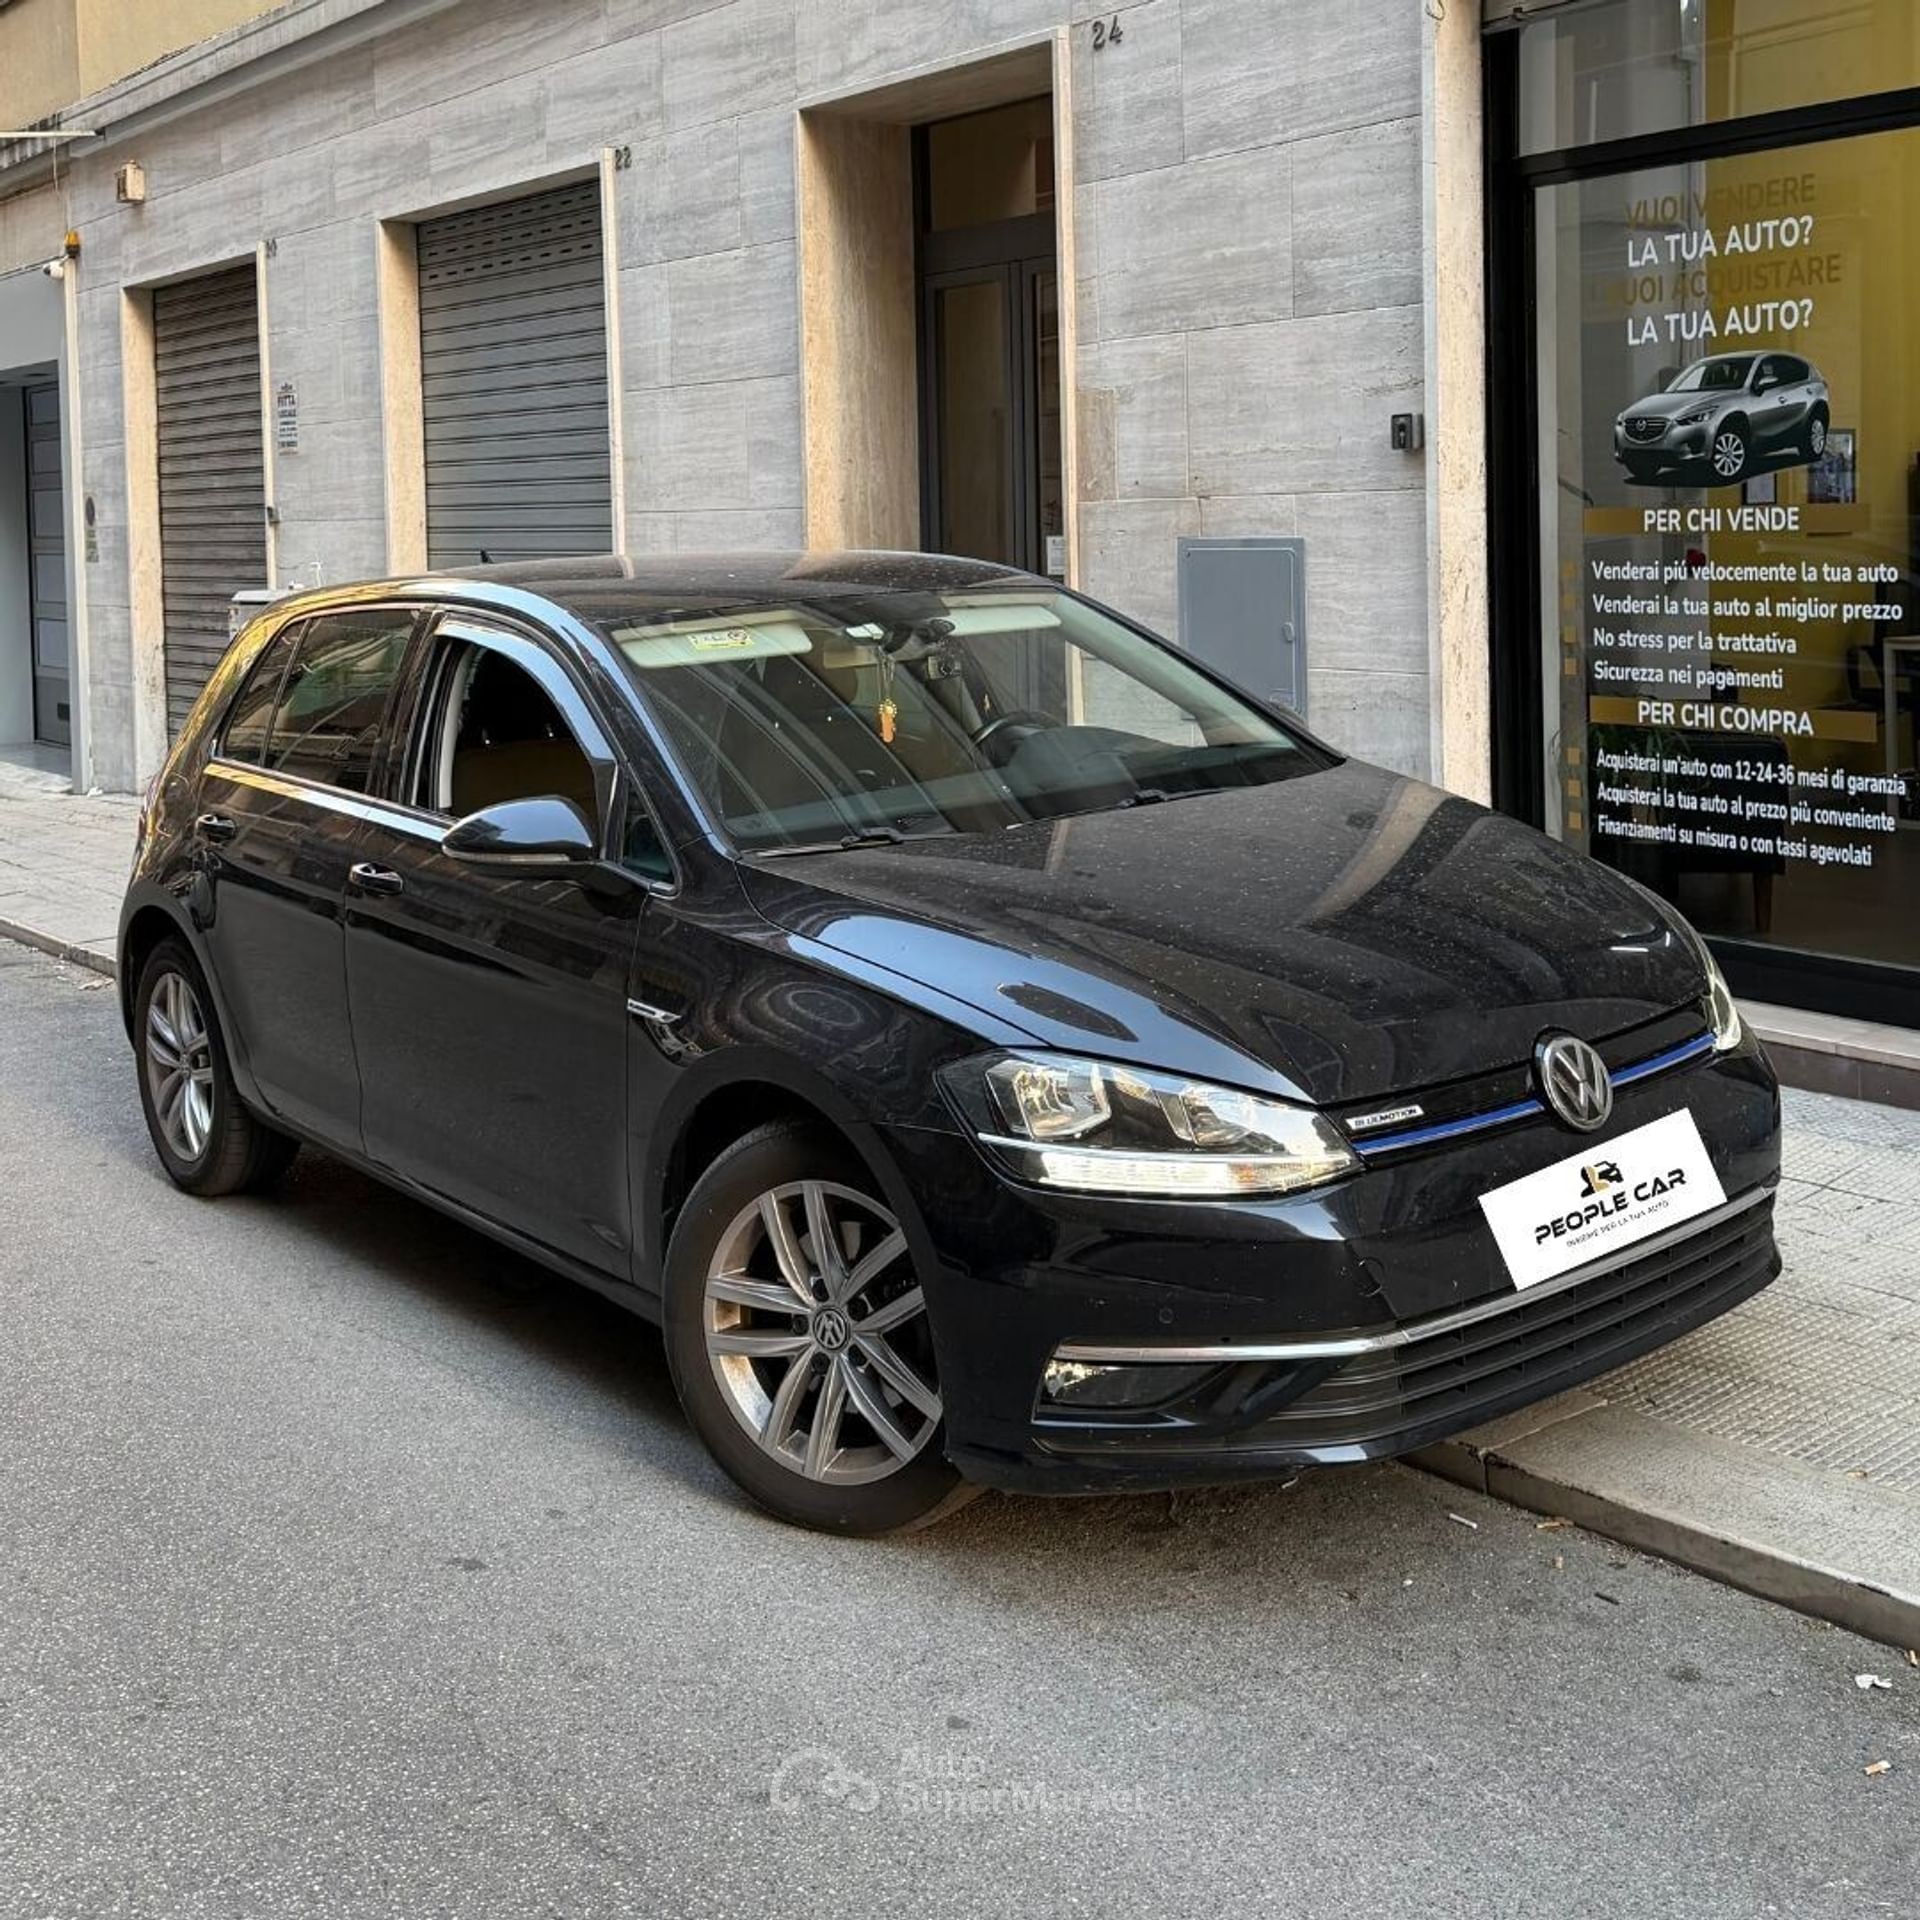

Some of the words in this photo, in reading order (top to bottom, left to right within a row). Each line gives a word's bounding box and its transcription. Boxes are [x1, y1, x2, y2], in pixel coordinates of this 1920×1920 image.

[1092, 14, 1123, 51] 24
[614, 145, 632, 170] 22
[1626, 194, 1686, 228] VUOI
[1693, 174, 1816, 218] VENDERE
[1628, 237, 1659, 268] LA
[1664, 229, 1717, 263] TUA
[1724, 215, 1814, 256] AUTO?
[1671, 254, 1842, 300] ACQUISTARE
[1628, 315, 1659, 346] LA
[1664, 309, 1717, 342] TUA
[1724, 298, 1814, 337] AUTO?
[1643, 508, 1681, 532] PER
[1686, 508, 1722, 532] CHI
[1726, 506, 1800, 532] VENDE
[1591, 560, 1659, 581] Venderai
[1691, 561, 1797, 582] velocemente
[1801, 560, 1818, 582] la
[1822, 562, 1852, 583] tua
[1856, 562, 1899, 583] auto
[1592, 593, 1660, 615] Venderai
[1663, 595, 1679, 615] la
[1682, 597, 1709, 616] tua
[1713, 597, 1751, 617] auto
[1754, 597, 1772, 617] al
[1775, 596, 1838, 623] miglior
[1842, 603, 1904, 624] prezzo
[1592, 627, 1615, 647] No
[1618, 629, 1664, 649] stress
[1667, 633, 1695, 653] per
[1698, 630, 1714, 650] la
[1717, 631, 1798, 654] trattativa
[1593, 660, 1664, 683] Sicurezza
[1667, 664, 1692, 684] nei
[1695, 668, 1784, 690] pagamenti
[1637, 700, 1676, 726] PER
[1681, 702, 1716, 729] CHI
[1719, 706, 1815, 736] COMPRA
[1596, 748, 1660, 773] Acquisterai
[1662, 754, 1708, 777] un'auto
[1709, 762, 1733, 780] con
[1735, 759, 1795, 786] 12-24-36
[1797, 766, 1829, 789] mesi
[1831, 767, 1846, 790] di
[1847, 773, 1907, 796] garanzia
[1596, 781, 1662, 807] Acquisterai
[1663, 787, 1676, 808] la
[1677, 790, 1698, 811] tua
[1699, 793, 1728, 815] auto
[1730, 794, 1744, 816] al
[1745, 800, 1788, 821] prezzo
[1790, 799, 1811, 826] più
[1813, 806, 1896, 832] conveniente
[1597, 813, 1677, 843] Finanziamenti
[1678, 827, 1693, 845] su
[1695, 825, 1737, 850] misura
[1739, 835, 1749, 851] o
[1750, 835, 1774, 853] con
[1776, 836, 1807, 859] tassi
[1809, 842, 1873, 867] agevolati
